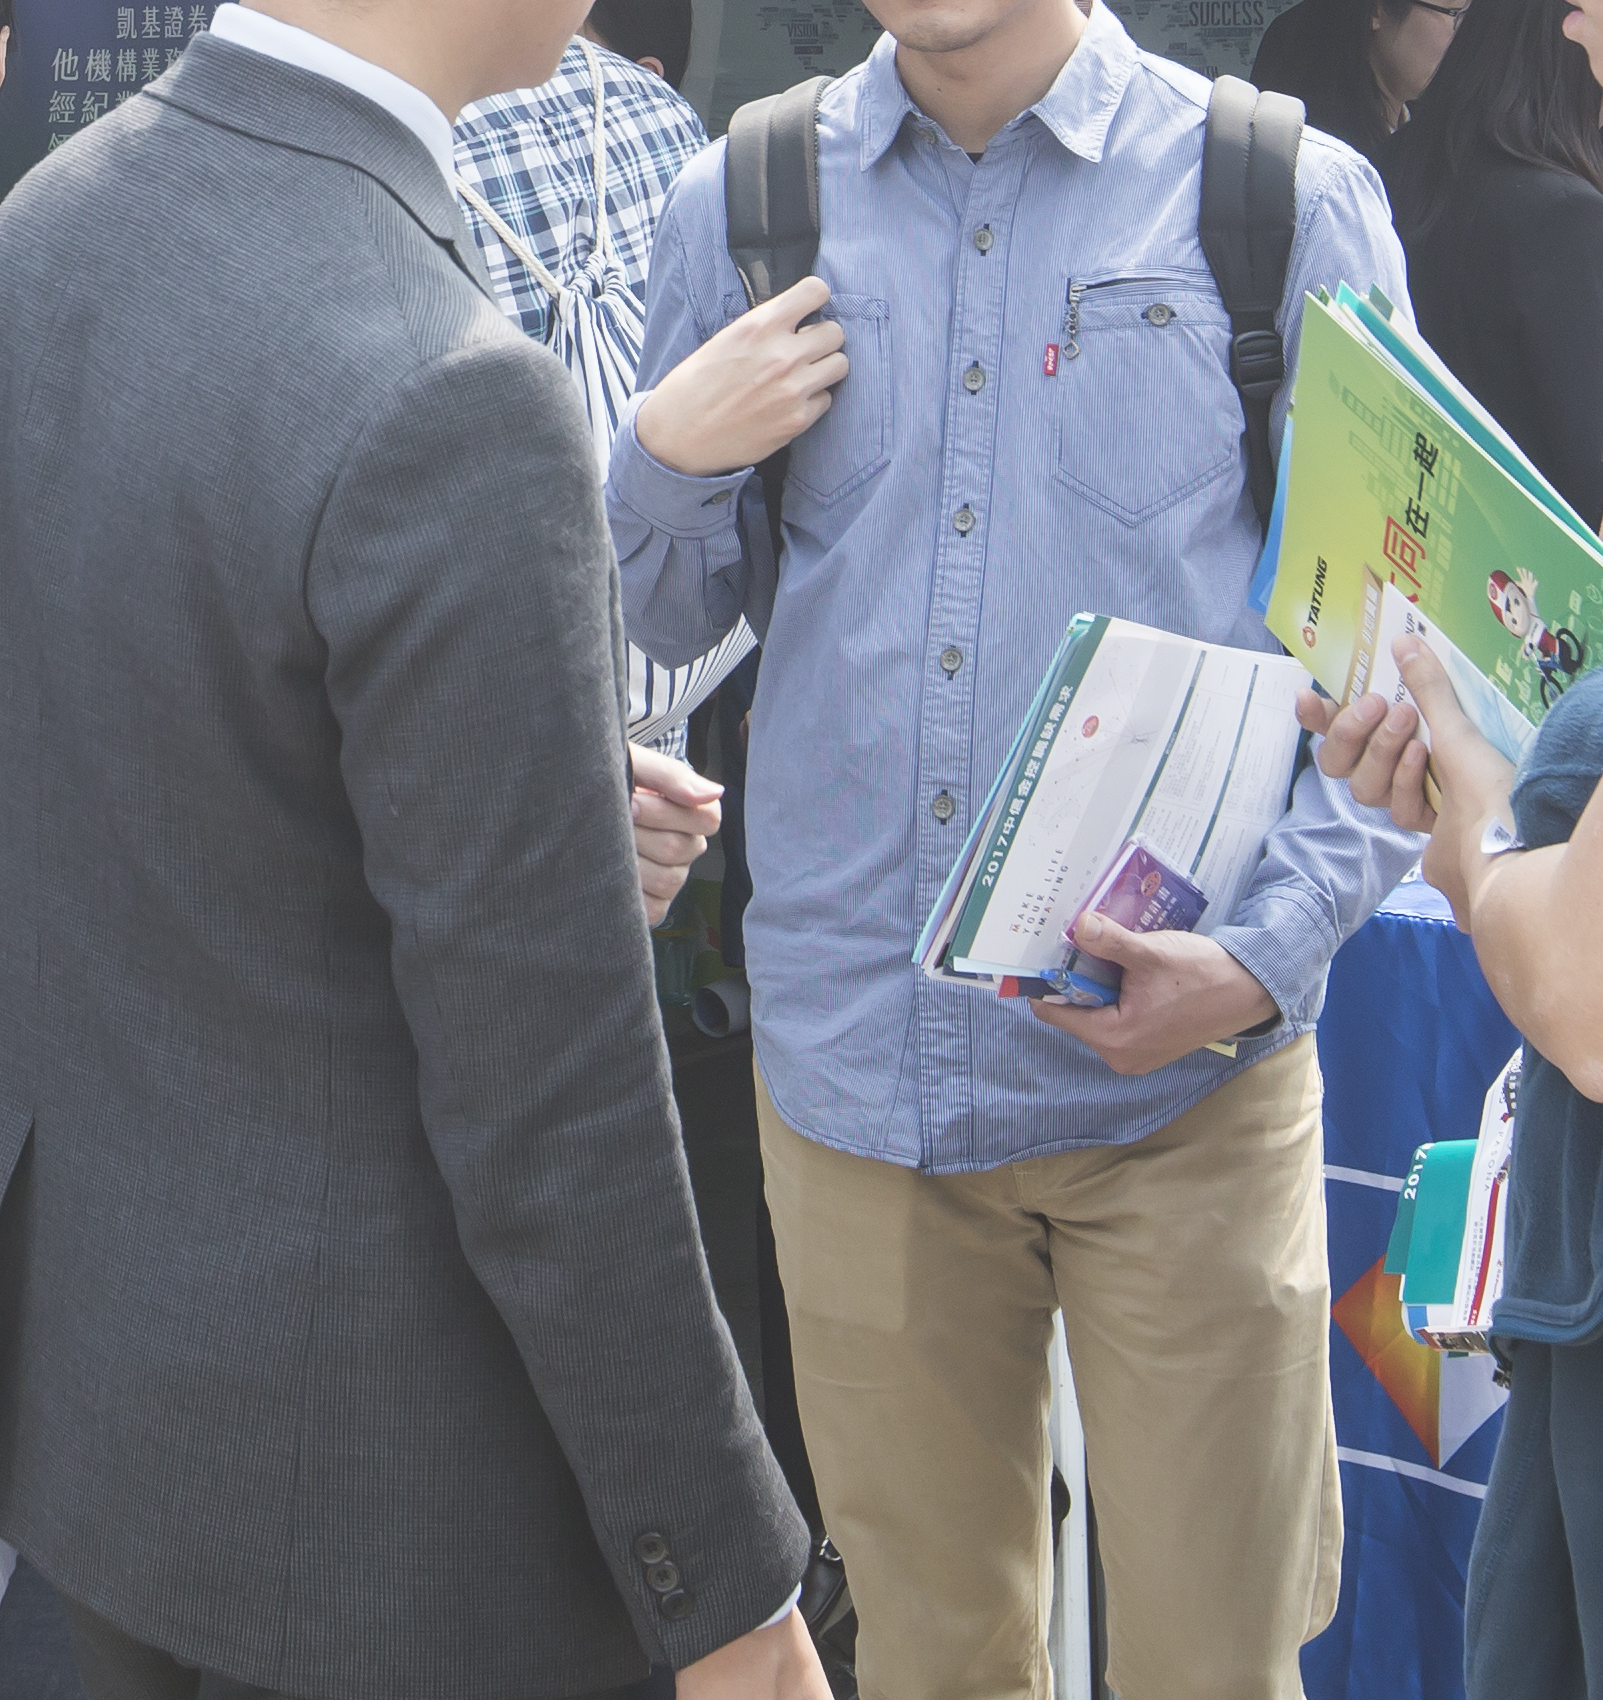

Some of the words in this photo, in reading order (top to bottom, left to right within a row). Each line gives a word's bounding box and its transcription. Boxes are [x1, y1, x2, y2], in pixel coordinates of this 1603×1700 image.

[116, 5, 218, 41] 凱基證券
[1189, 1, 1264, 27] SUCCESS
[1307, 555, 1328, 627] TATUNG
[1012, 892, 1034, 933] MAKE
[1022, 894, 1045, 935] YOUR
[1044, 849, 1063, 882] LIFE
[1034, 865, 1069, 937] AMAZING
